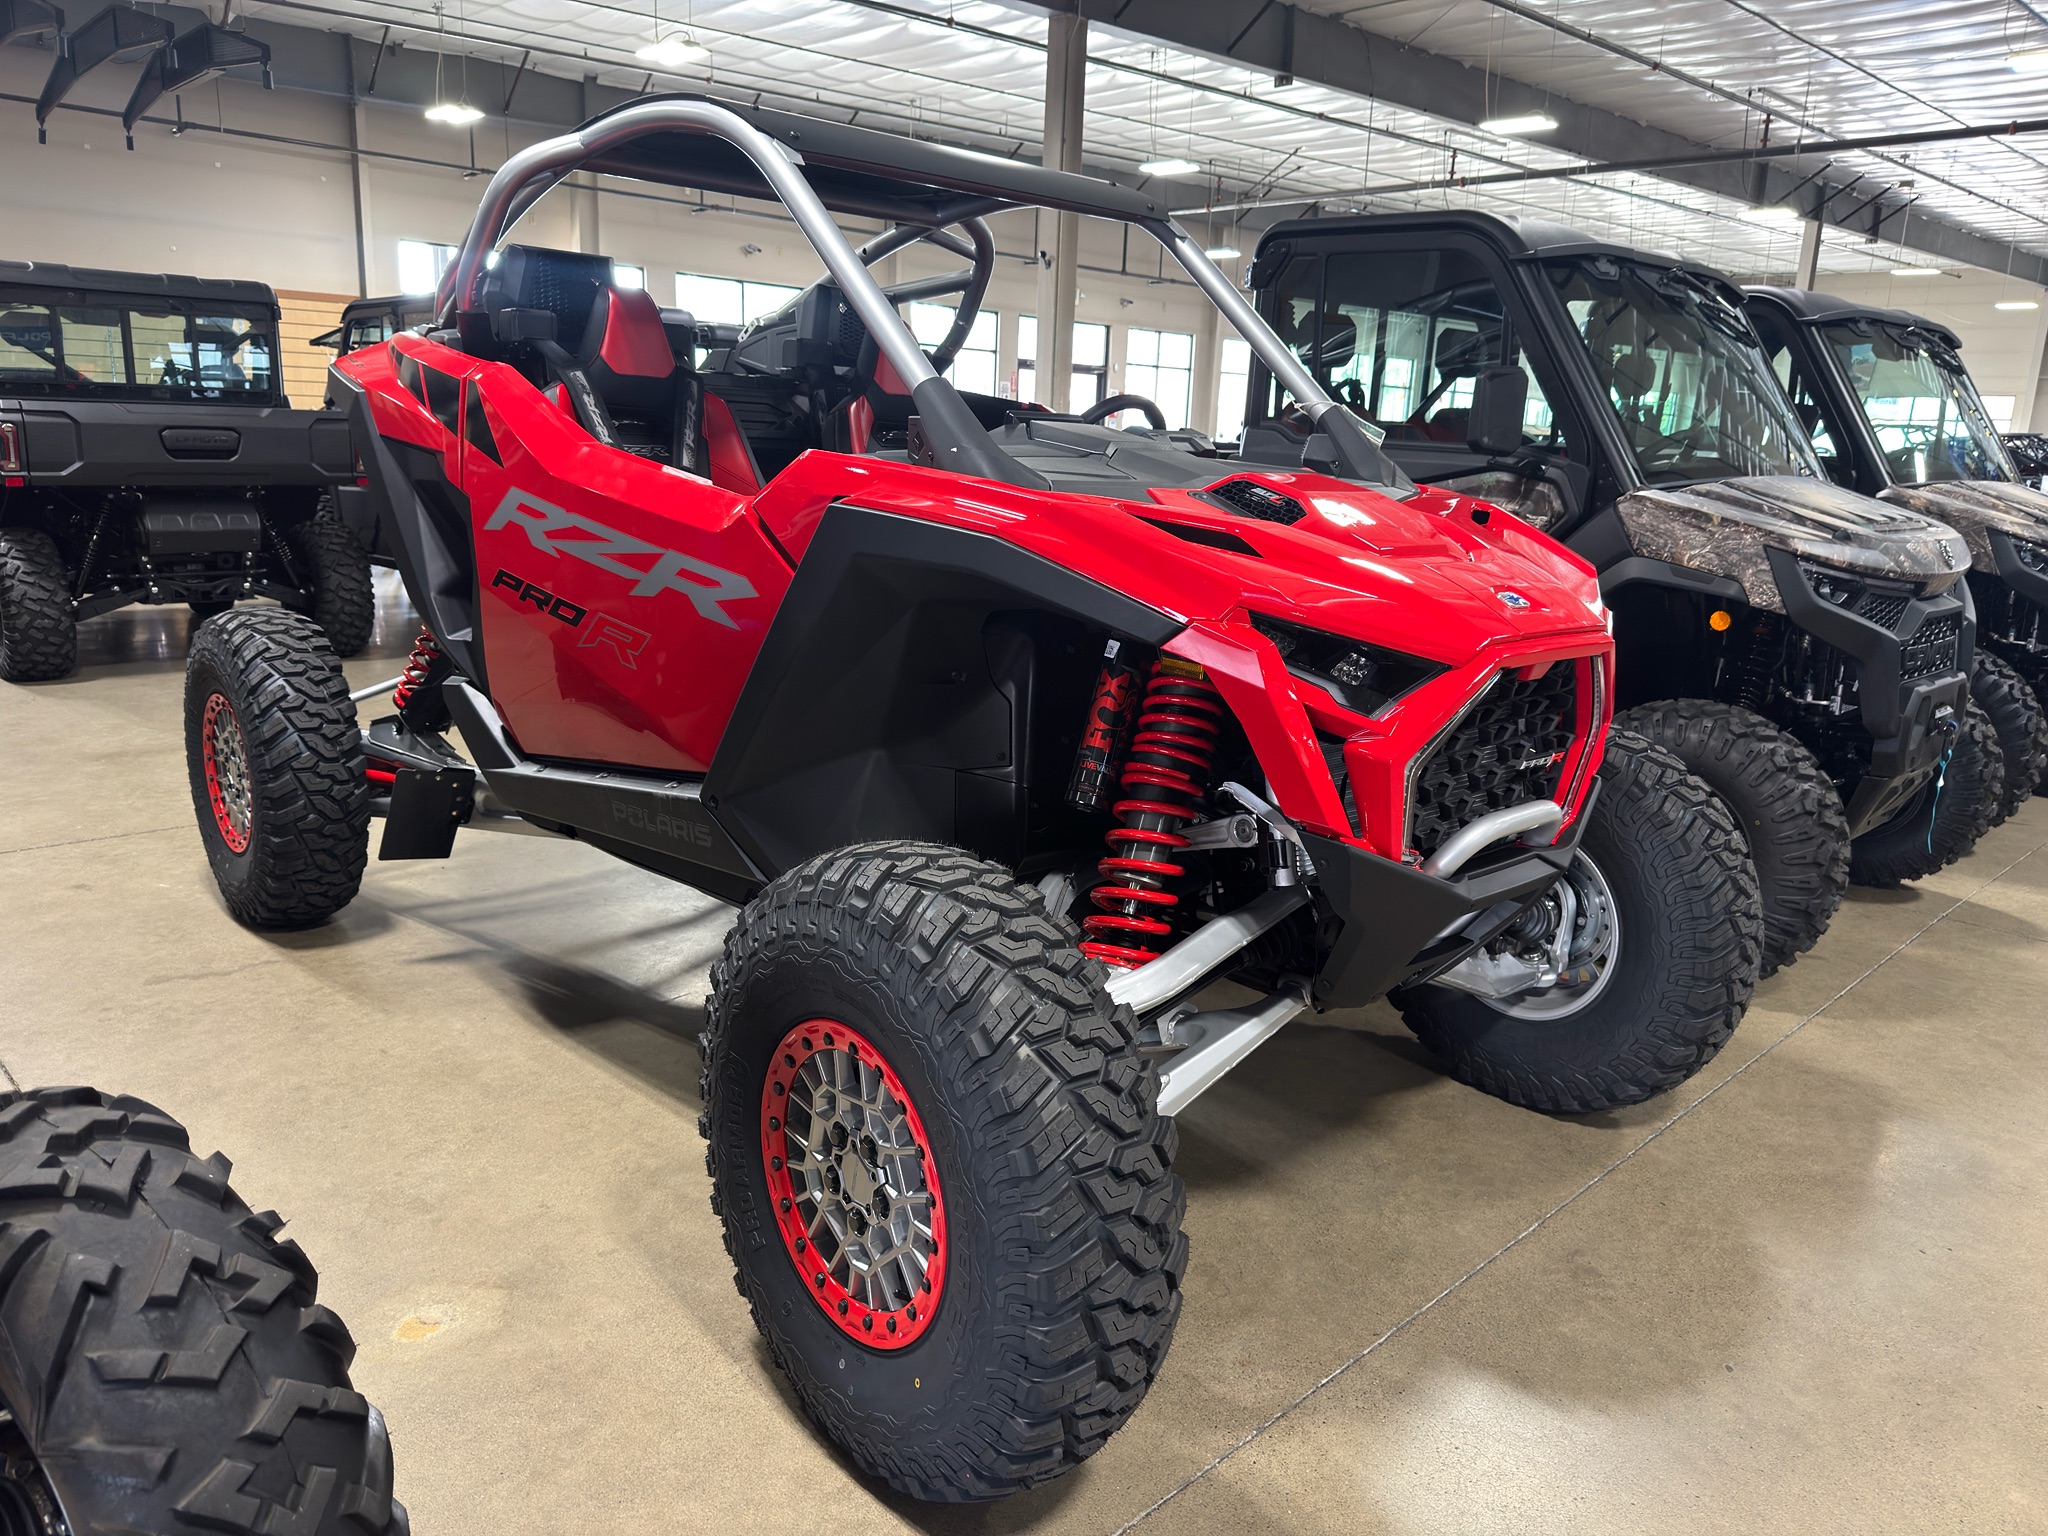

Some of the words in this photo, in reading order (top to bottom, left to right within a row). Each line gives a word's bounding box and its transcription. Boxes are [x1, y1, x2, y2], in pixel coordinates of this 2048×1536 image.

[483, 486, 759, 630] RZR
[492, 569, 587, 627] PRO
[577, 613, 651, 670] R
[1081, 668, 1131, 753] FOX
[611, 801, 712, 847] POLARIS
